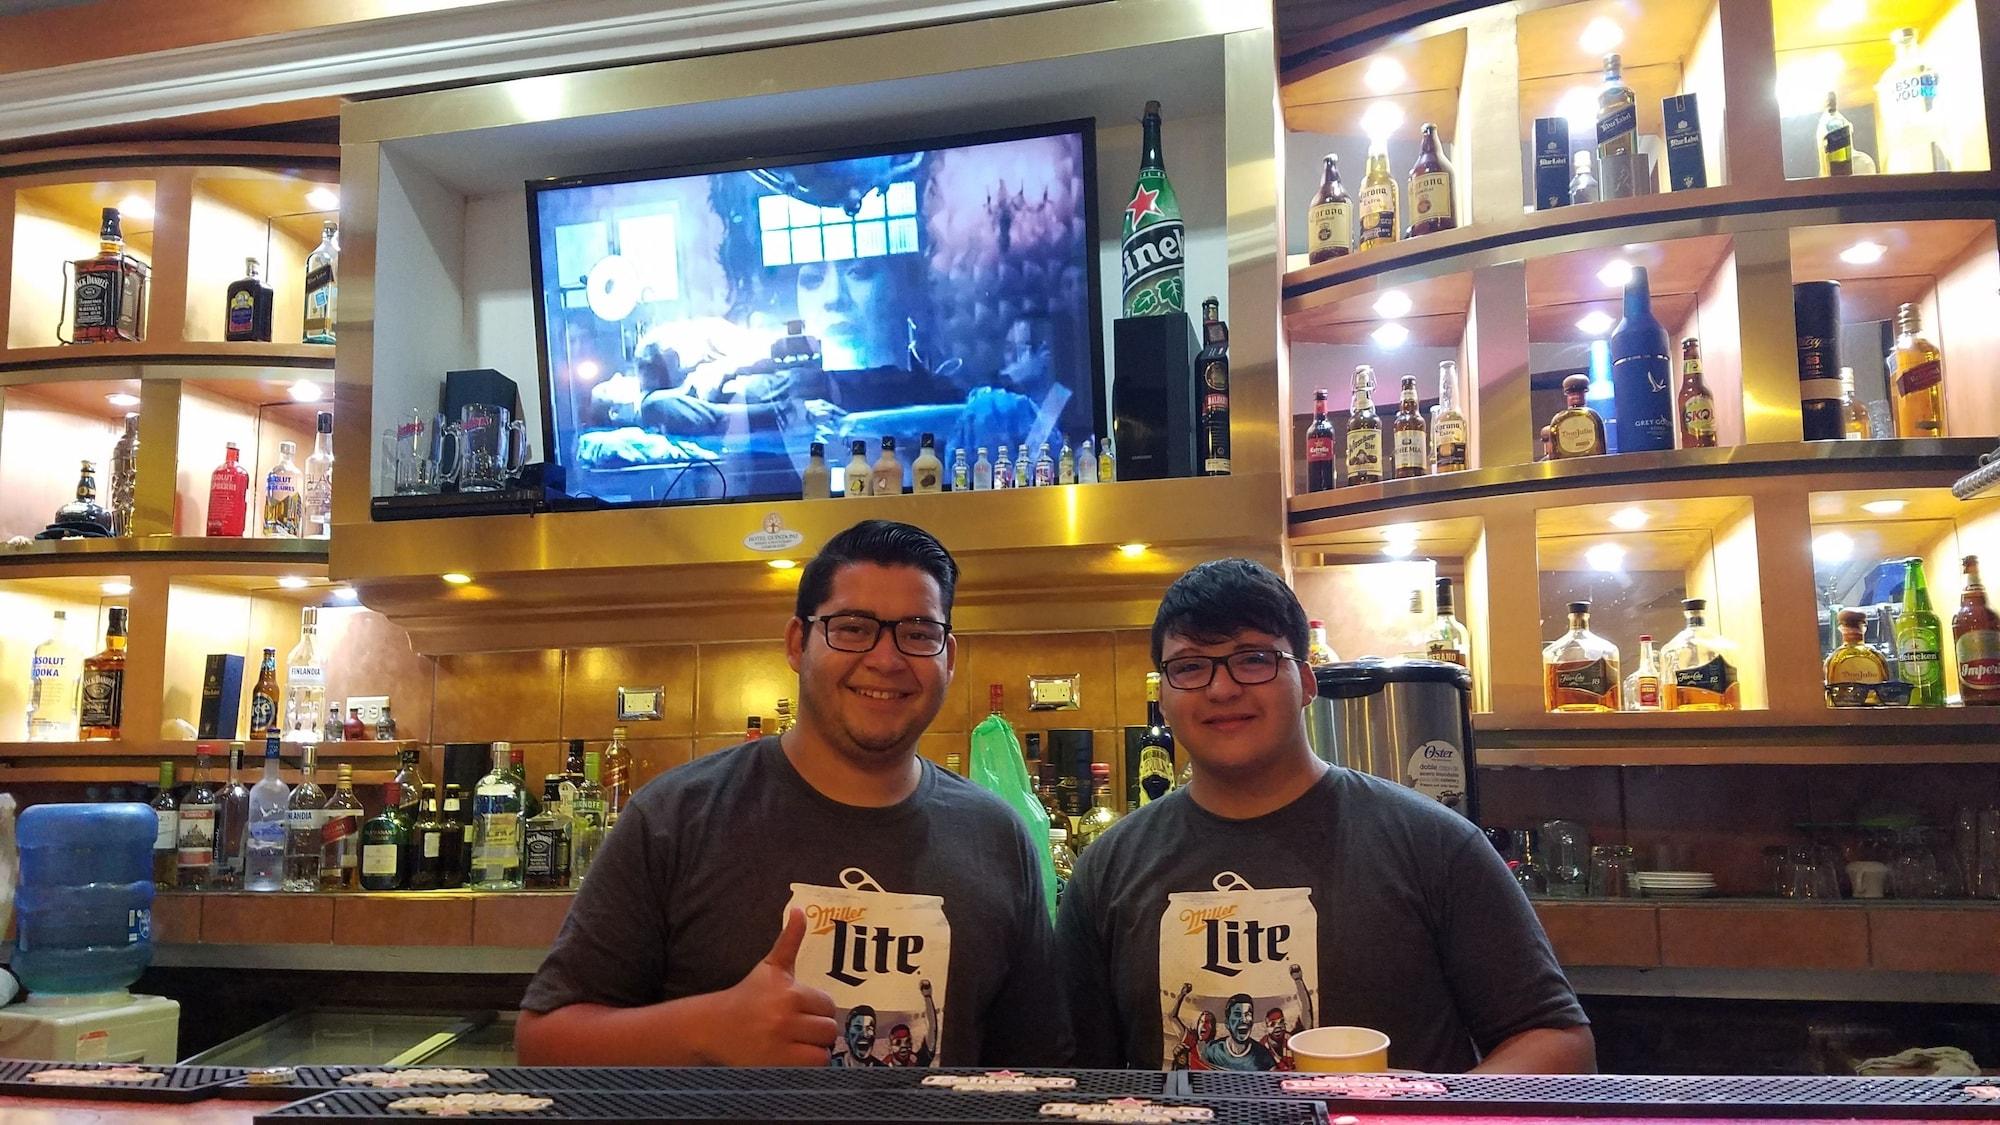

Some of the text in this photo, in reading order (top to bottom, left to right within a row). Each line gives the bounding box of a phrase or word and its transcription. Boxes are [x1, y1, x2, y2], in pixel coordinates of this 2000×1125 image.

[1634, 418, 1654, 427] GREY
[291, 667, 321, 676] FINLANDIA
[1424, 745, 1453, 759] Oster
[805, 904, 868, 935] Miller
[1179, 904, 1239, 936] Miller
[826, 918, 925, 987] Lite
[1201, 919, 1291, 977] Lite
